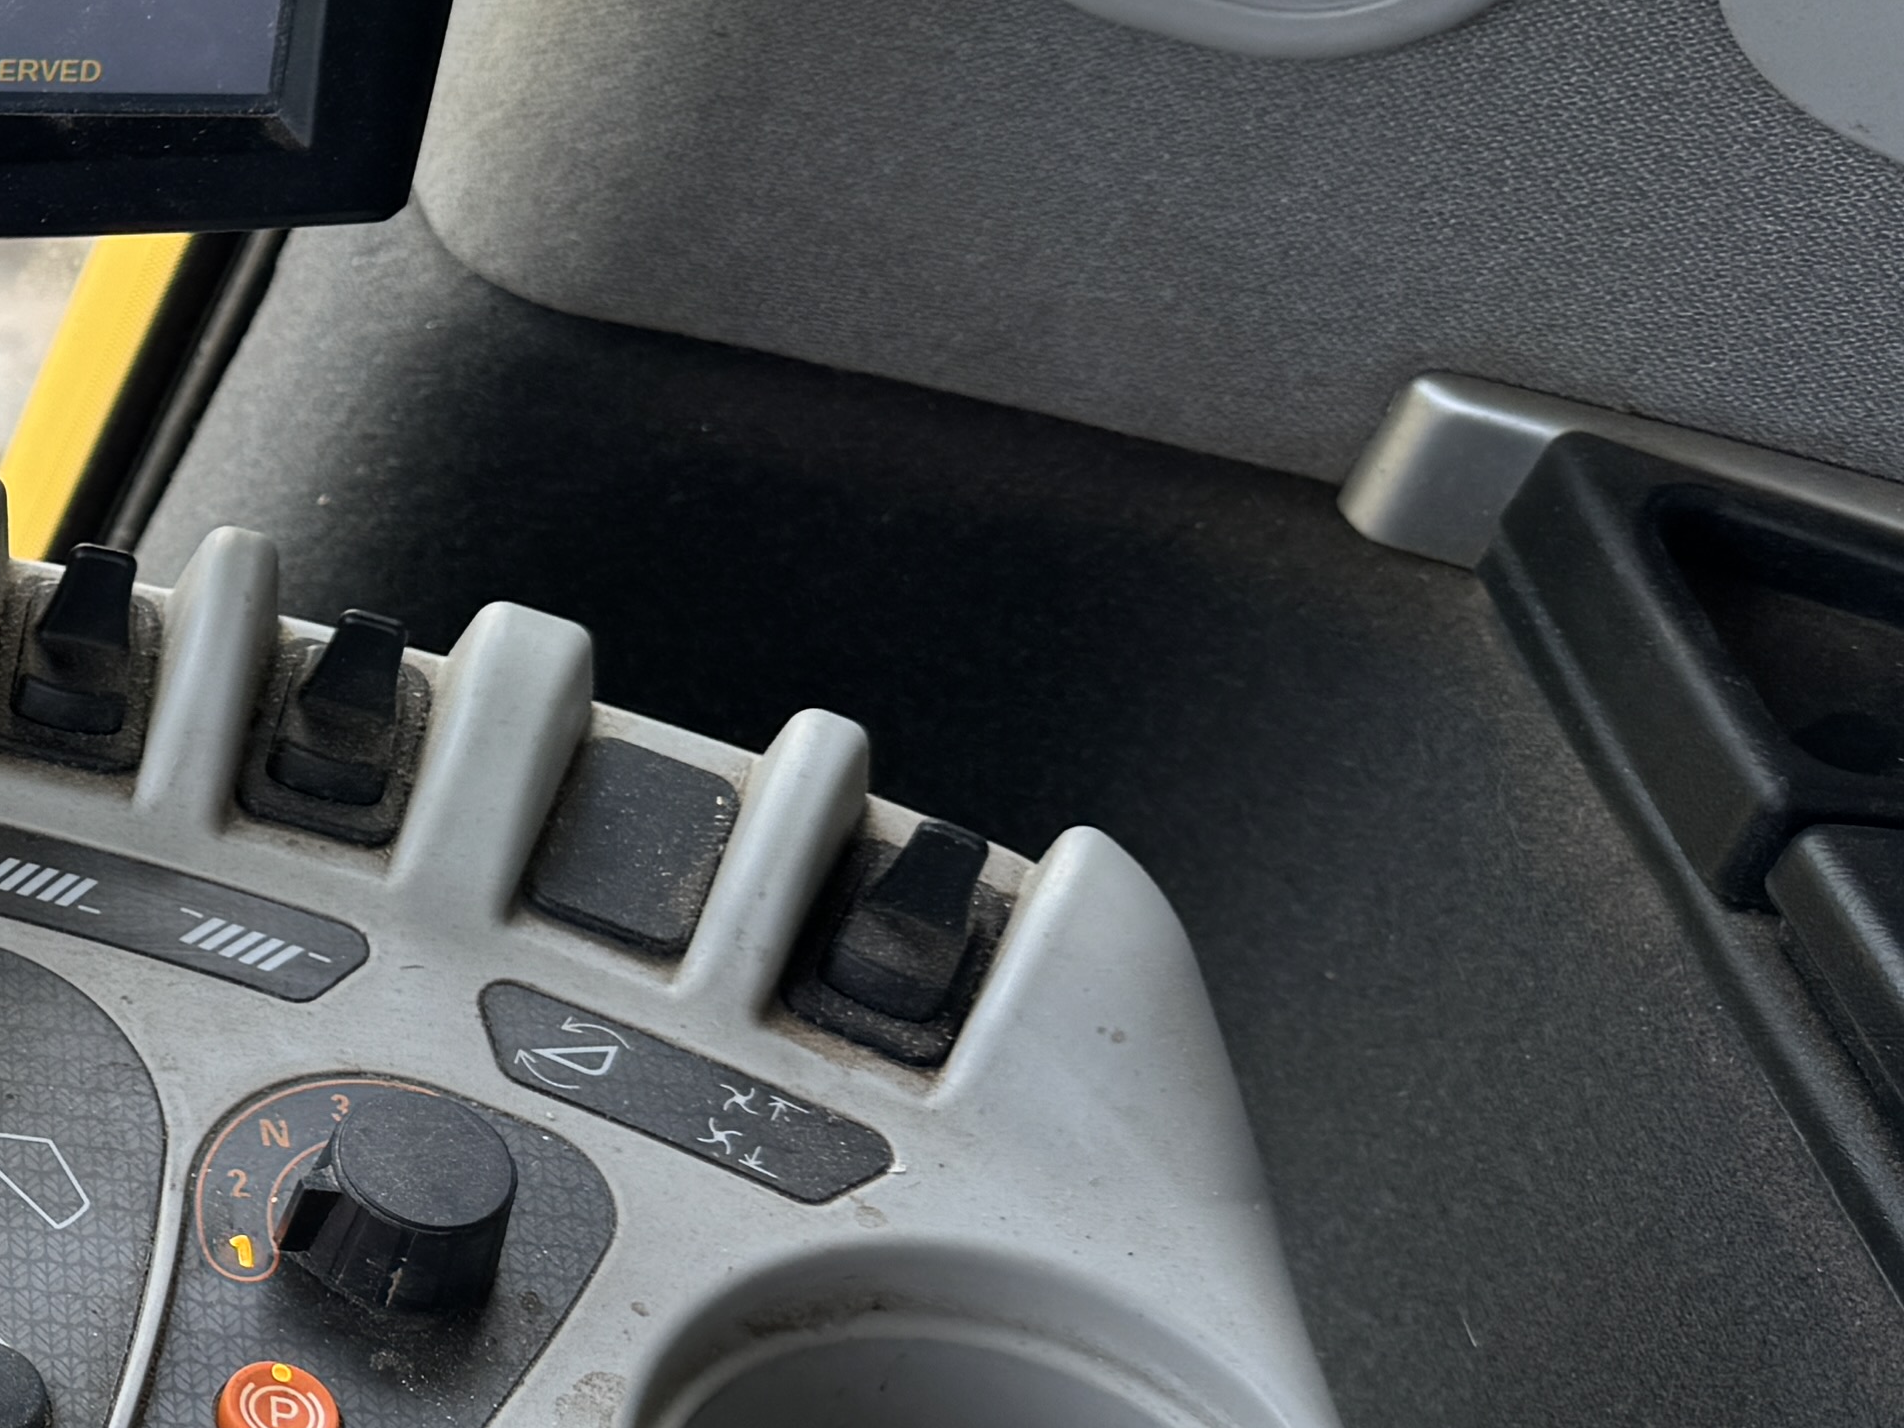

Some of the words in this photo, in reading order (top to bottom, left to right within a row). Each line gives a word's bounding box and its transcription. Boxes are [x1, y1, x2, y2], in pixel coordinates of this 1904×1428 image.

[330, 1093, 350, 1122] 3
[259, 1119, 291, 1148] N
[227, 1169, 250, 1198] 2
[229, 1234, 254, 1268] 1
[270, 1395, 299, 1428] P
